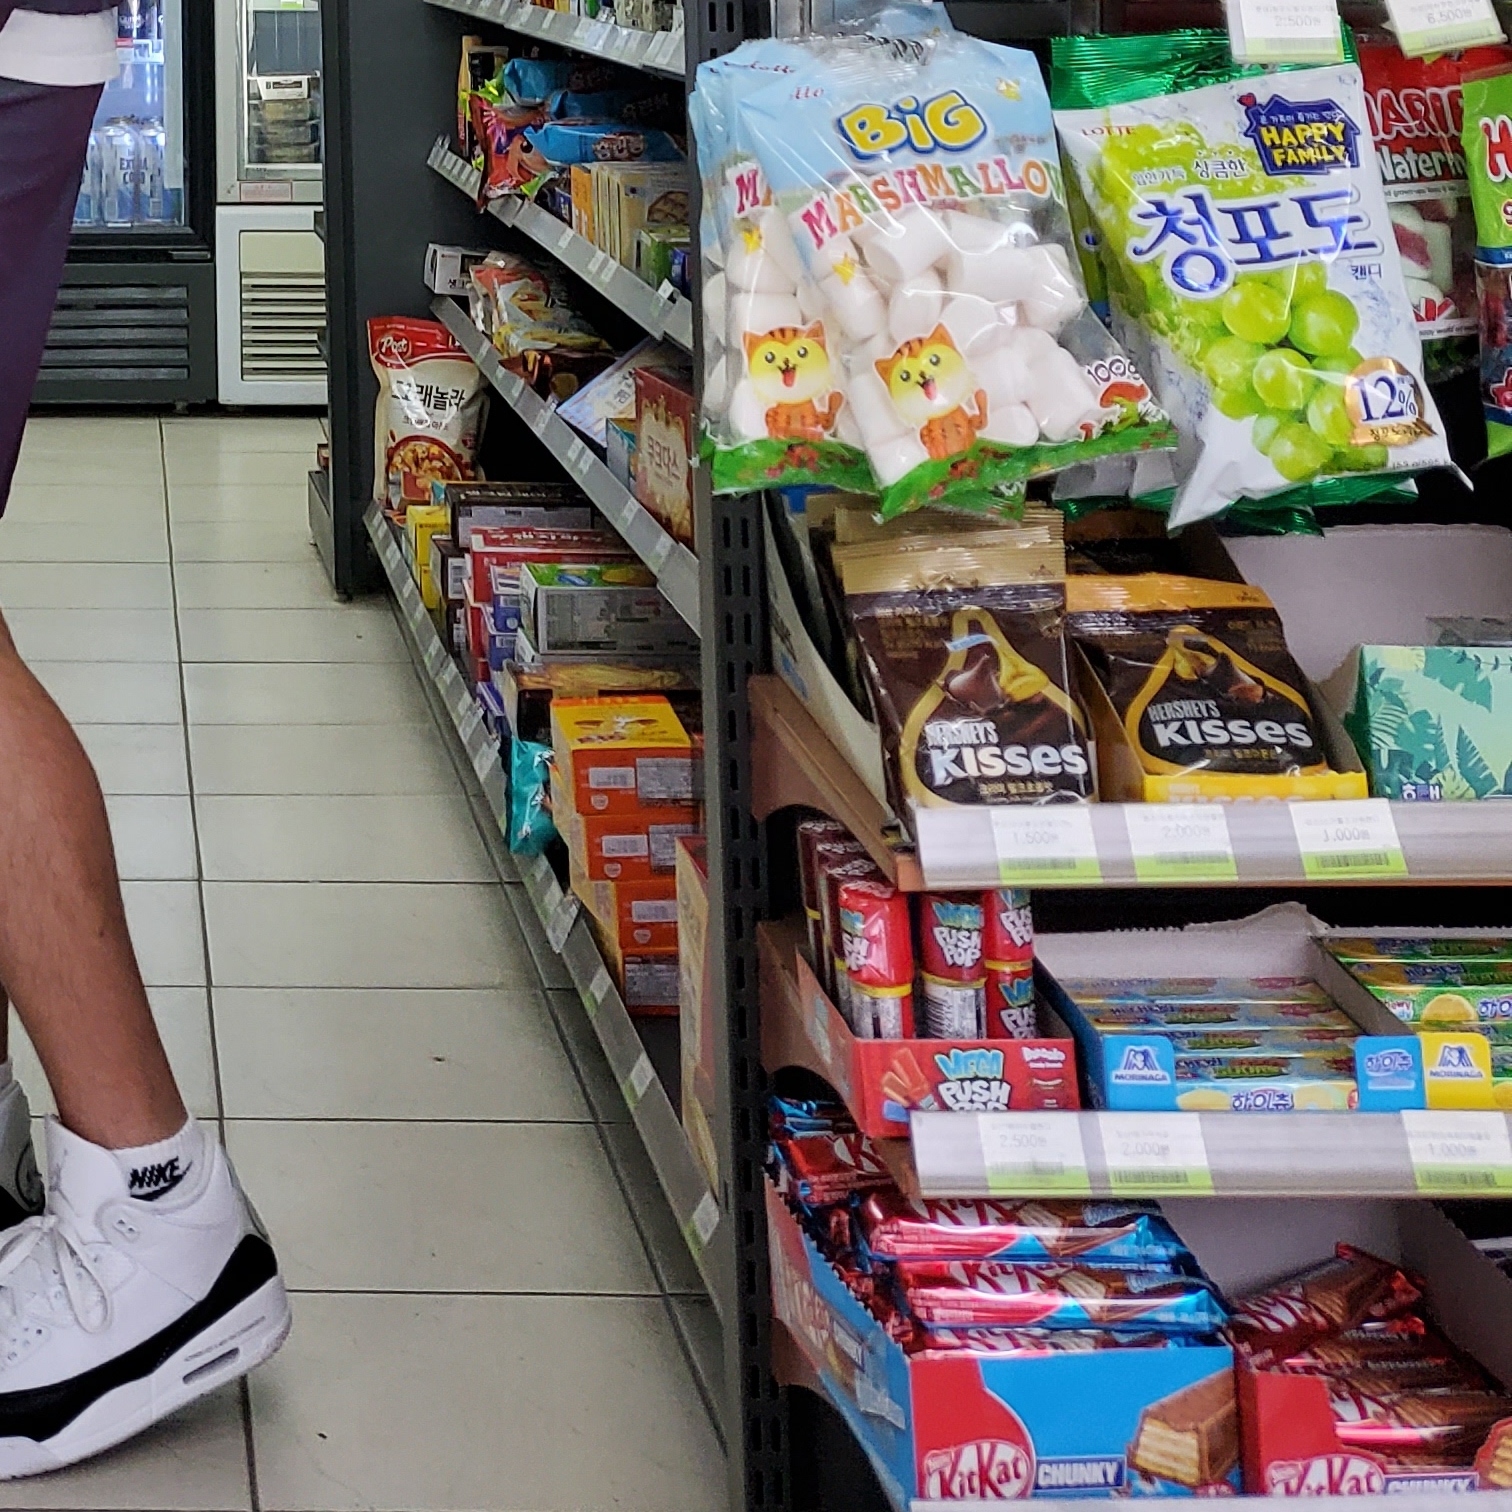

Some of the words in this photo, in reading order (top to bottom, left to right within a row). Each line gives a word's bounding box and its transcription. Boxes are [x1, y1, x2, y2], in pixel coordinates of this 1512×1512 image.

[1081, 125, 1137, 137] LOTTE
[1260, 121, 1346, 148] HAPPY
[1194, 155, 1249, 180] 상큼한
[1131, 188, 1378, 296] 청포도
[1350, 262, 1383, 281] 캔디
[381, 334, 409, 354] Post
[1087, 358, 1143, 386] 100g
[1353, 371, 1418, 423] 12%
[1148, 698, 1221, 723] HERSHEY'S
[1000, 908, 1033, 935] PUS
[934, 927, 982, 950] PUSH
[944, 946, 982, 968] POP
[1476, 997, 1512, 1018] 하이
[1365, 1049, 1413, 1072] 하이츄
[1114, 1071, 1169, 1084] MORINAGA
[1429, 1069, 1484, 1080] MORINAGA
[937, 1078, 1012, 1103] PUSH
[129, 1155, 182, 1190] NIKE
[928, 1440, 1026, 1498] KitKat
[1038, 1461, 1119, 1487] CHUNKY
